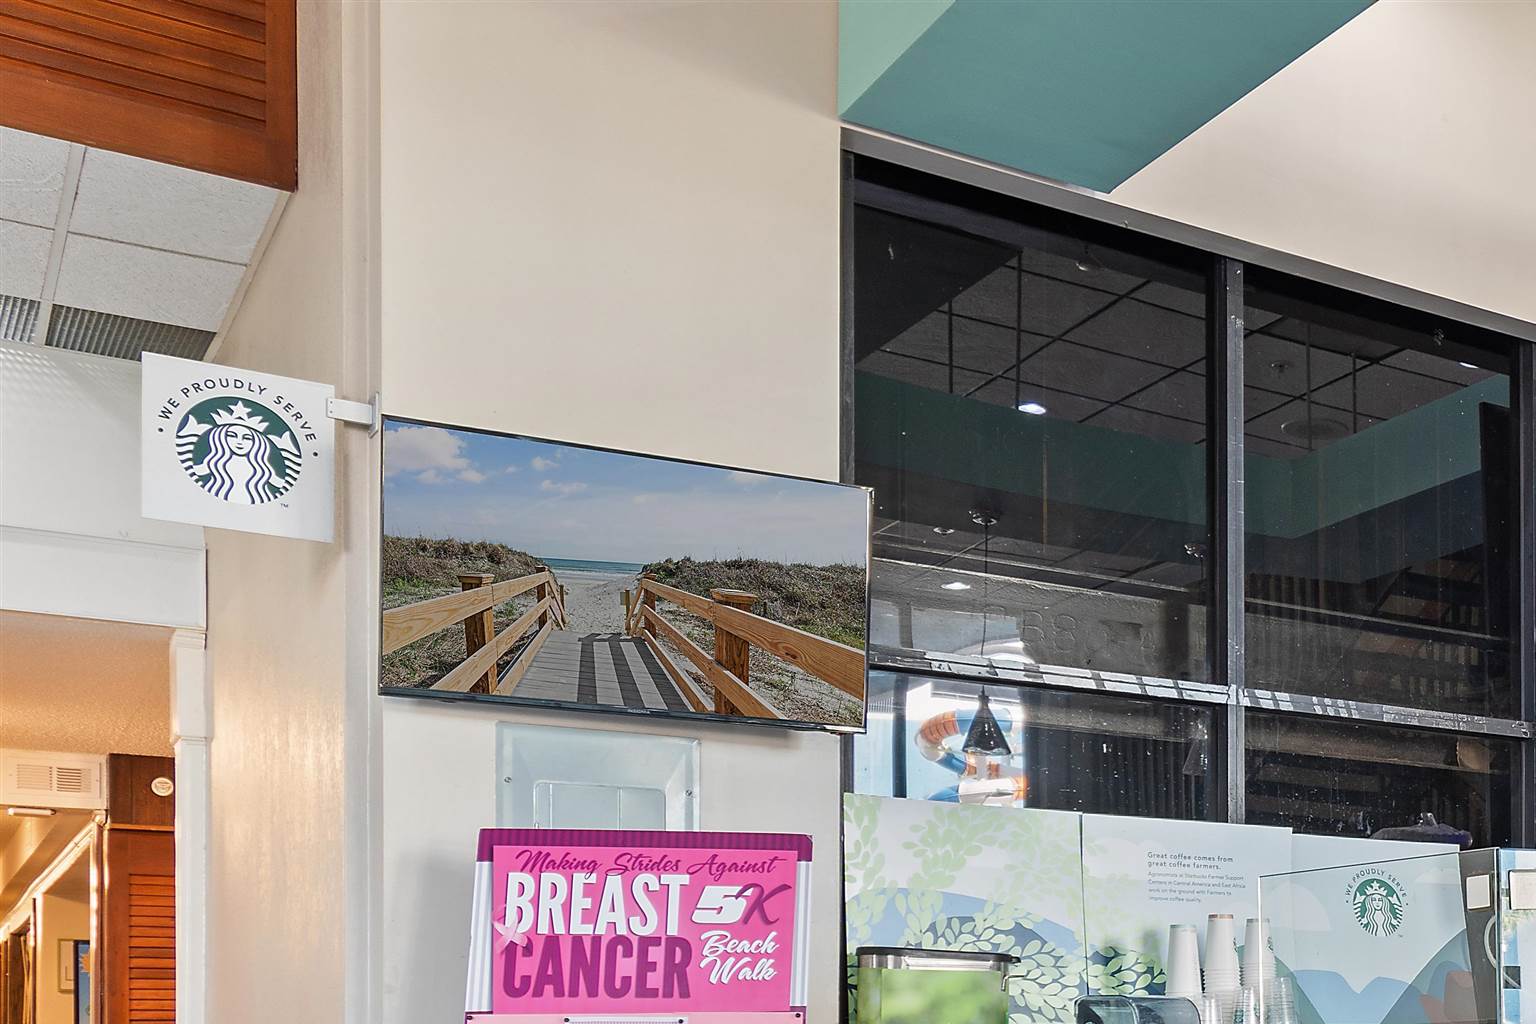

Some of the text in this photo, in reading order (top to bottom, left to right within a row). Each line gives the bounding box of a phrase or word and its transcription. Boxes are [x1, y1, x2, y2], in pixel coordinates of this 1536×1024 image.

[158, 377, 317, 443] WE PROUDLY SERVE
[515, 848, 782, 880] Making Strides Against
[1345, 868, 1408, 898] WE PROUDLY SERVE
[503, 871, 691, 937] BREAST
[691, 881, 793, 927] 5K
[700, 930, 778, 959] Beach
[502, 935, 693, 1000] CANCER
[700, 956, 778, 985] Walk
